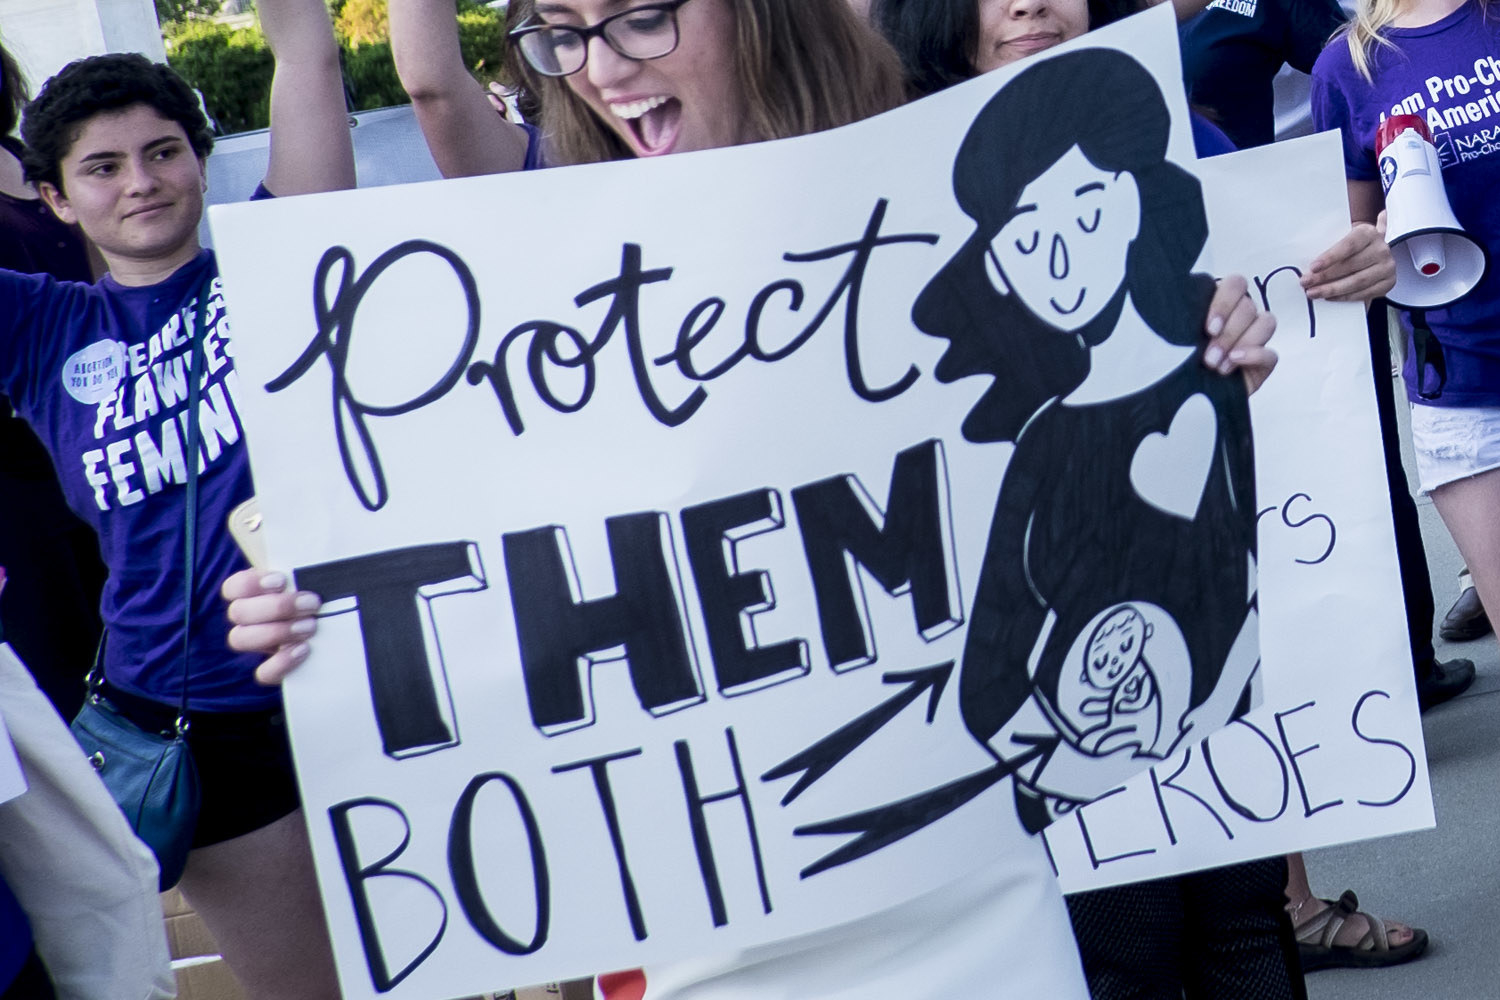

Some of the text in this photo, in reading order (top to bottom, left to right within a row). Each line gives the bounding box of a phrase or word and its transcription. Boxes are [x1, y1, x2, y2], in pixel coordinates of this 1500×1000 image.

[264, 198, 941, 512] Protect
[294, 438, 965, 761] THEM
[328, 726, 773, 994] BOTH
